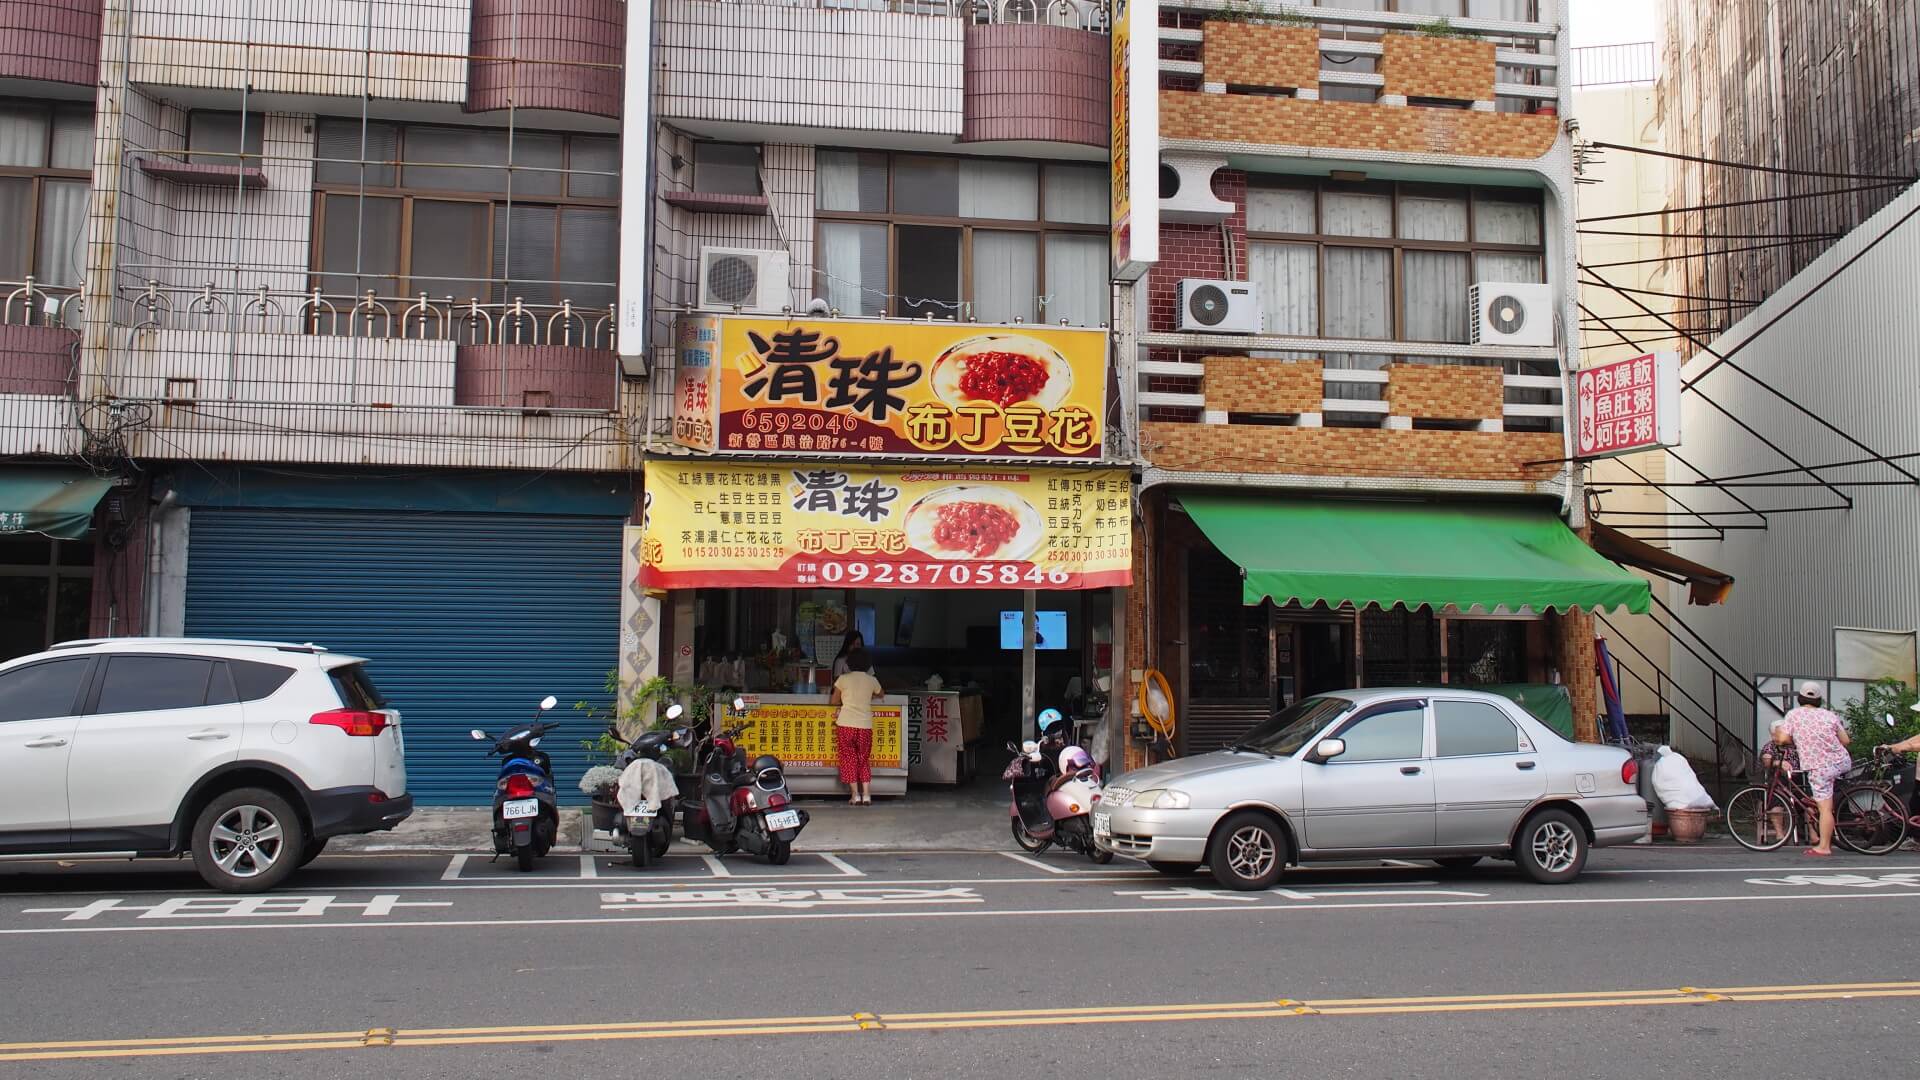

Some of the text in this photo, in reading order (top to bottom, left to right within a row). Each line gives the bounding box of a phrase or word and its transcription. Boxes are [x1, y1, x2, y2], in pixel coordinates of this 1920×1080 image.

[743, 327, 922, 421] 清珠
[683, 376, 707, 413] 清珠
[1596, 387, 1652, 421] 魚肚粥
[676, 417, 713, 443] 布丁豆花
[742, 409, 858, 435] 6592046
[907, 402, 1092, 445] 布丁豆花
[1596, 415, 1652, 448] 蚵仔粥
[744, 473, 756, 544] 花生豆花
[770, 473, 783, 544] 黑豆豆花
[793, 470, 898, 522] 清珠
[1048, 479, 1057, 547] 紅豆豆花
[1072, 480, 1082, 548] 巧克力布丁
[1108, 480, 1118, 546] 三色布丁
[682, 547, 784, 557] 10 15 20 30 25 30 25 25
[797, 528, 907, 551] 布丁豆花
[1048, 548, 1129, 561] 25 20 30 30 30 30 30
[822, 562, 1070, 585] 0928705846
[926, 695, 948, 743] 紅茶
